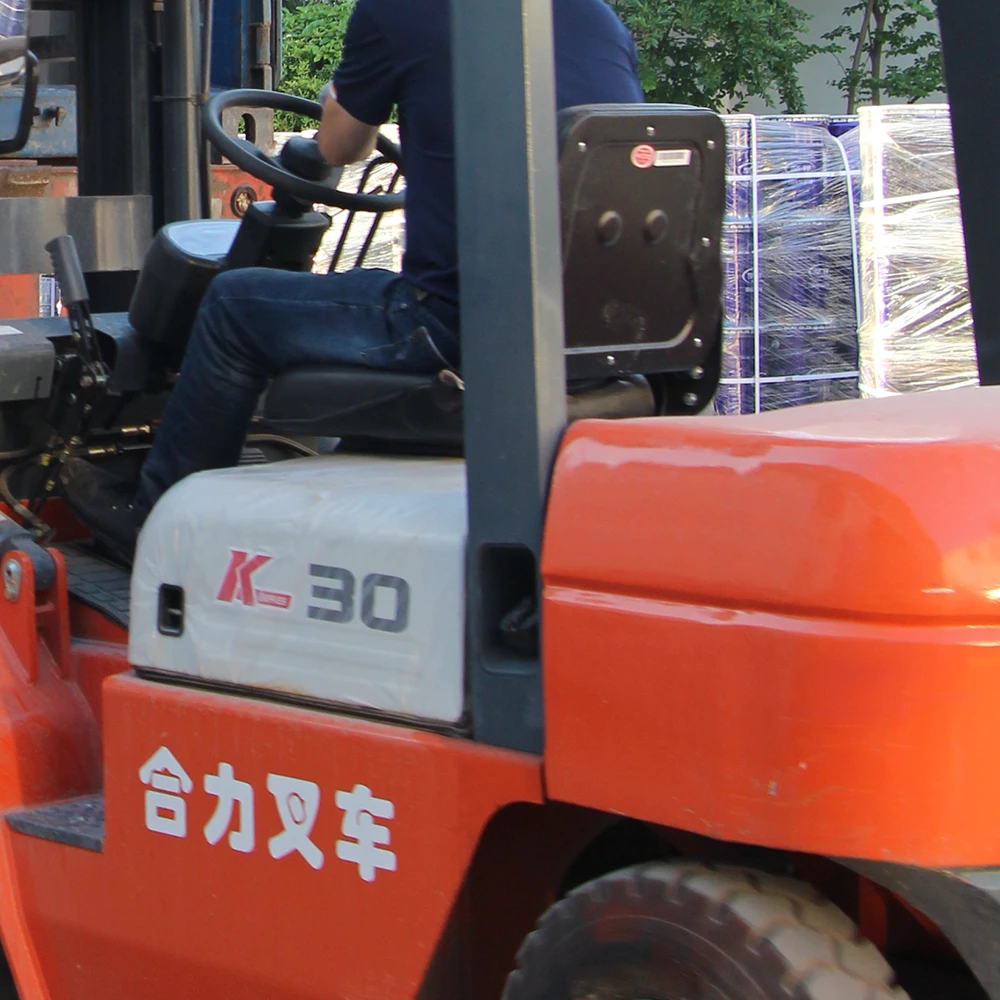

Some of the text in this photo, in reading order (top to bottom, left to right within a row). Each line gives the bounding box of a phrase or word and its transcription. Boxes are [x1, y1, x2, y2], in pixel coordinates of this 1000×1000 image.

[307, 562, 410, 634] 30
[138, 745, 398, 882] 合力叉车
